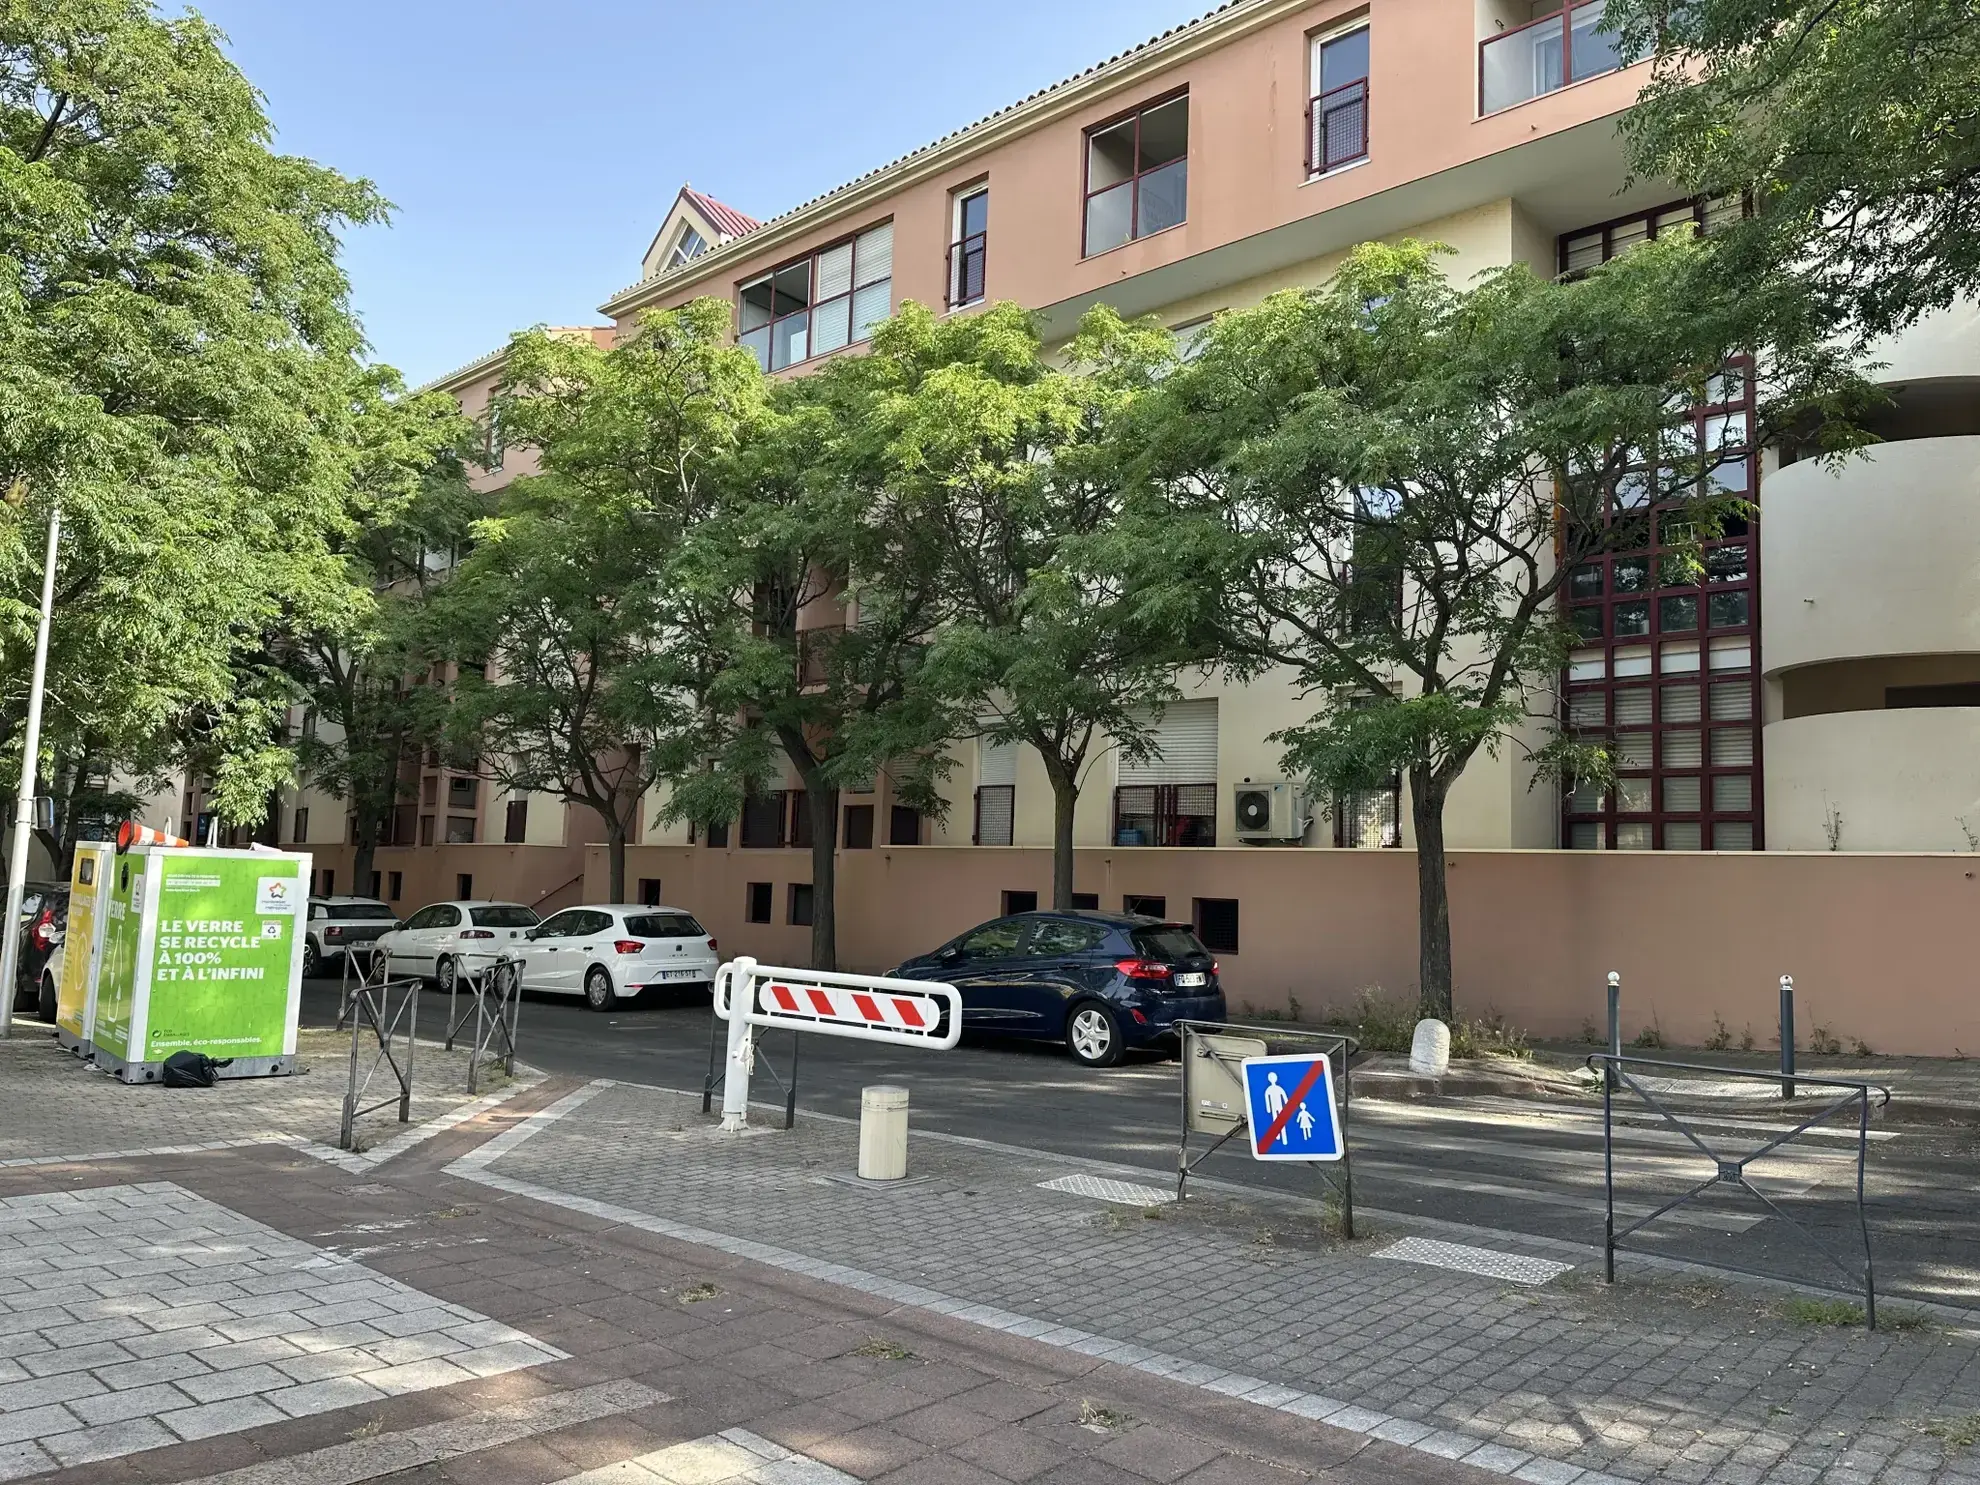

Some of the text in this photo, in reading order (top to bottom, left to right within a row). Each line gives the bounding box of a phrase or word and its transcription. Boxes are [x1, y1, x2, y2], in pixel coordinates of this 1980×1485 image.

[109, 900, 126, 920] VERRE
[161, 920, 243, 933] LE VERRE
[159, 936, 261, 949] SE RECYCLE
[158, 950, 222, 965] À 100%
[157, 966, 265, 981] ET À L'INFINI
[151, 1036, 262, 1048] Ensemble, éco-responsables.
